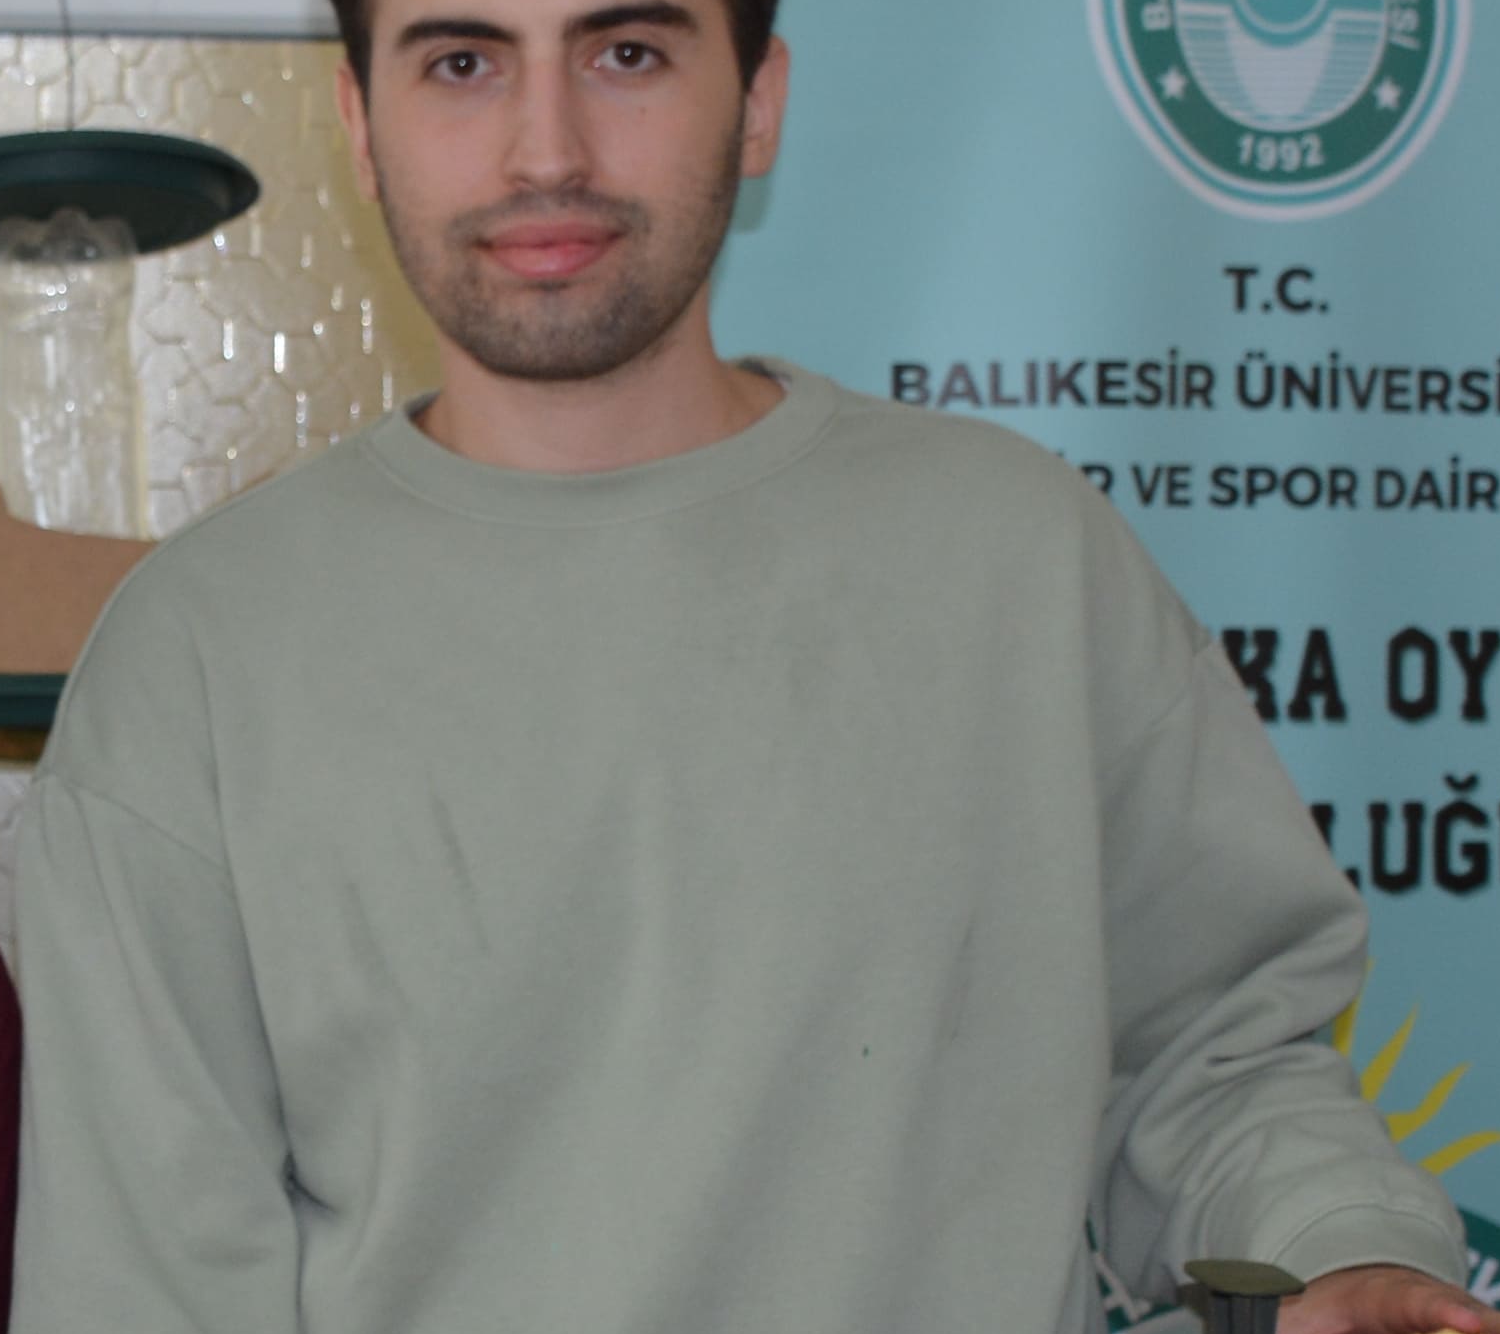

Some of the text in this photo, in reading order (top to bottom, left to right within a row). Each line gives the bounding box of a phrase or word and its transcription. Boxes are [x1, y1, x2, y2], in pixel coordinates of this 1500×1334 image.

[1238, 134, 1326, 172] 1992
[1225, 266, 1328, 314] T.C.
[891, 349, 1215, 410] BALIKESİR
[1131, 463, 1193, 508] VE
[1208, 464, 1358, 513] SPOR
[1221, 627, 1348, 724] KA
